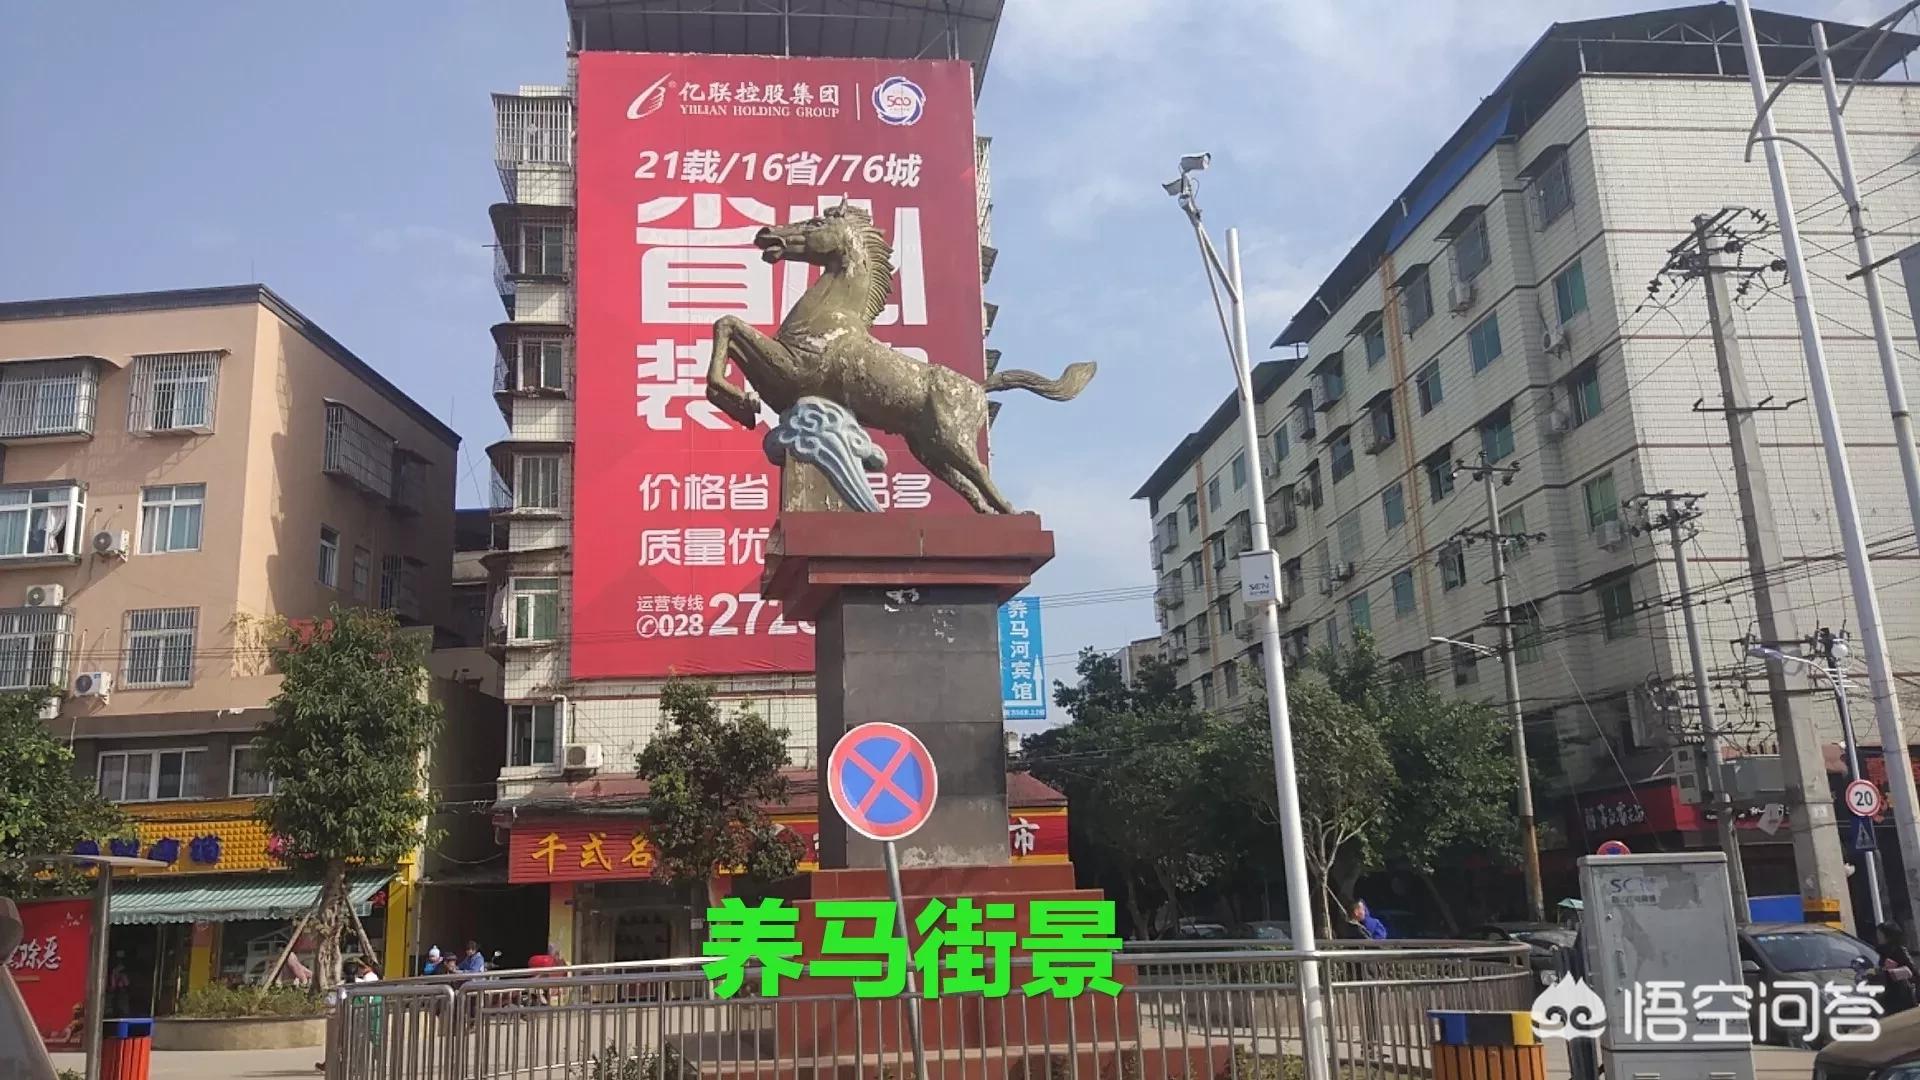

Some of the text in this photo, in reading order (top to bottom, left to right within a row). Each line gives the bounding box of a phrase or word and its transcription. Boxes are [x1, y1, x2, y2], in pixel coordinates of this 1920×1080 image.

[678, 81, 840, 106] 亿联控股集团
[733, 105, 791, 117] HOLDING
[795, 106, 840, 118] GROUP
[634, 149, 923, 188] 21载/16省/76城
[639, 473, 769, 511] 价格省
[638, 527, 769, 566] 质量优
[636, 594, 704, 612] 运营专线
[658, 592, 816, 637] 028 272
[1007, 600, 1033, 700] 养马河宾馆
[1854, 790, 1873, 807] 20
[1008, 817, 1040, 856] 市
